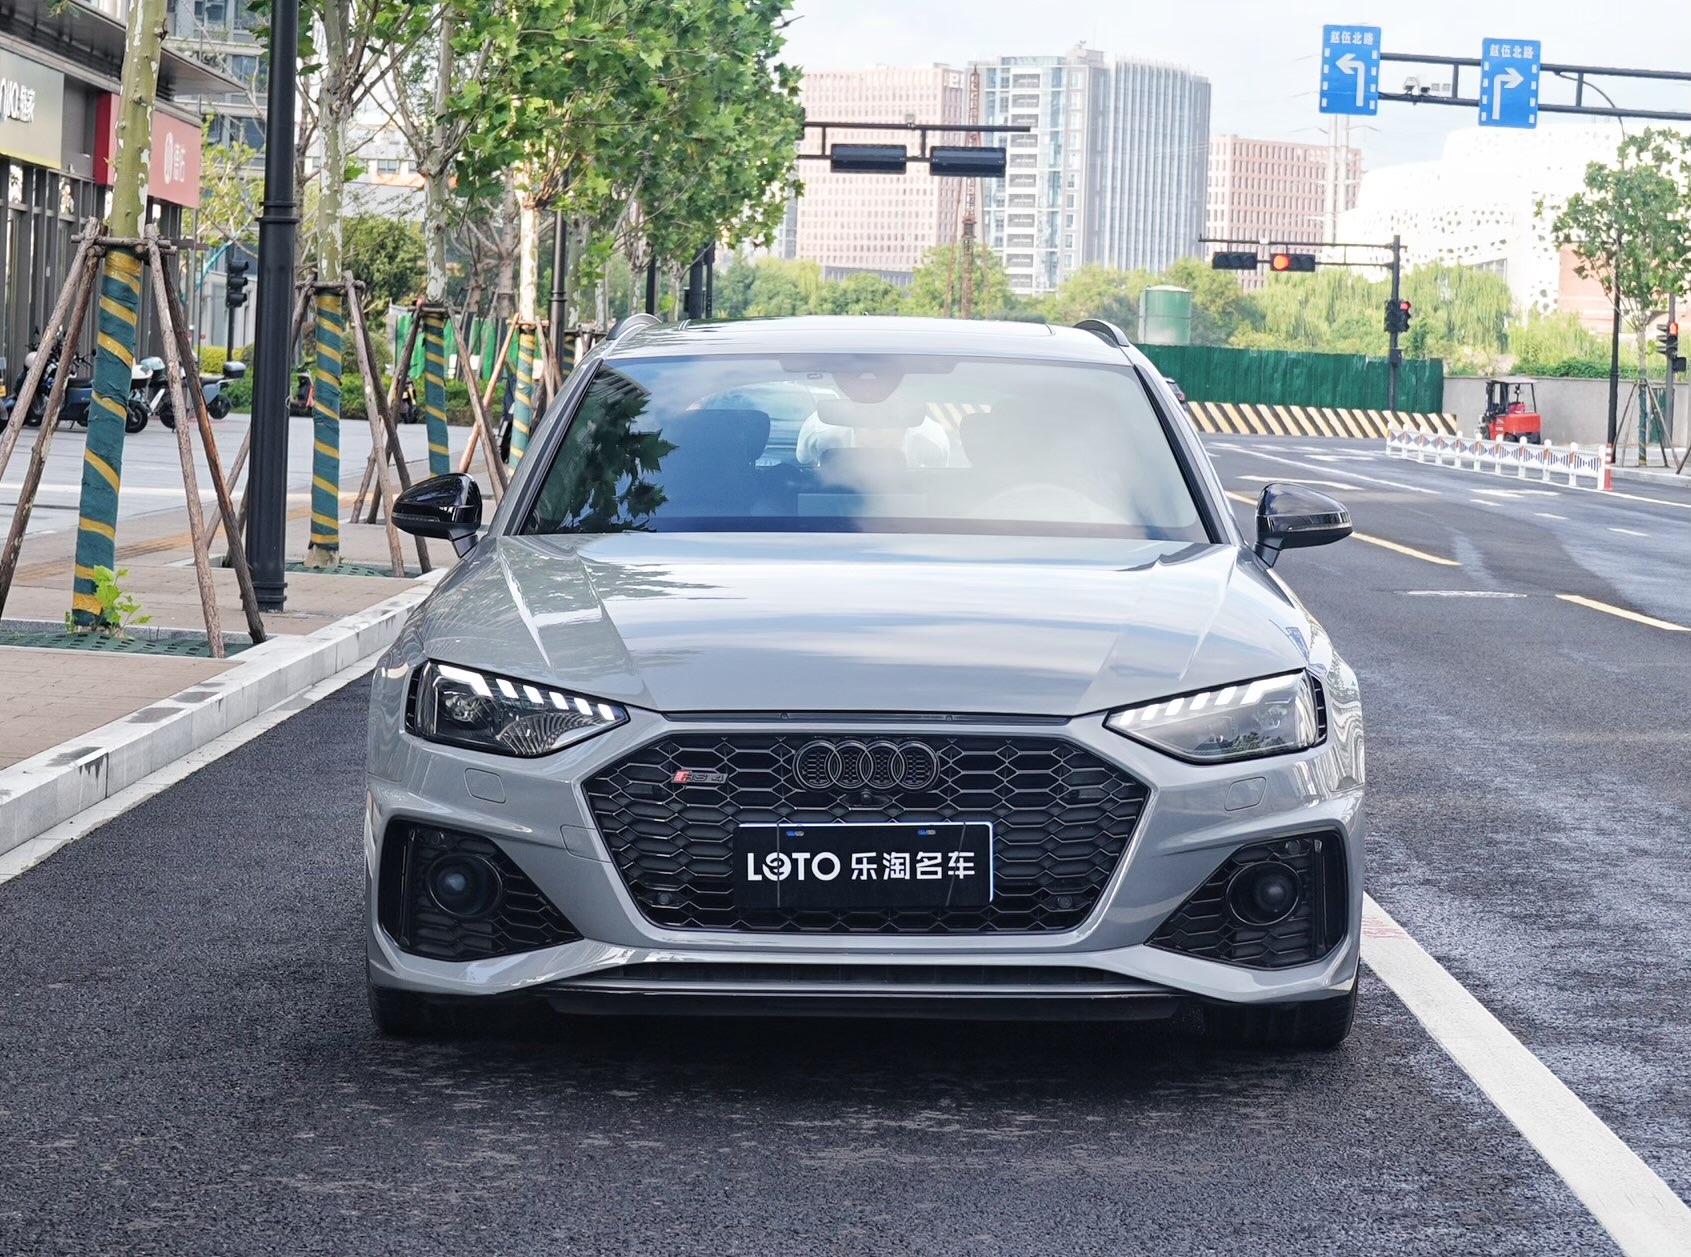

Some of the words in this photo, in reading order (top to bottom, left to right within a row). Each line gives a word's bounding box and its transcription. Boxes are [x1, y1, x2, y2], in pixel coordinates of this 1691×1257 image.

[747, 851, 841, 881] LOTO
[851, 851, 976, 881] 乐淘名车
